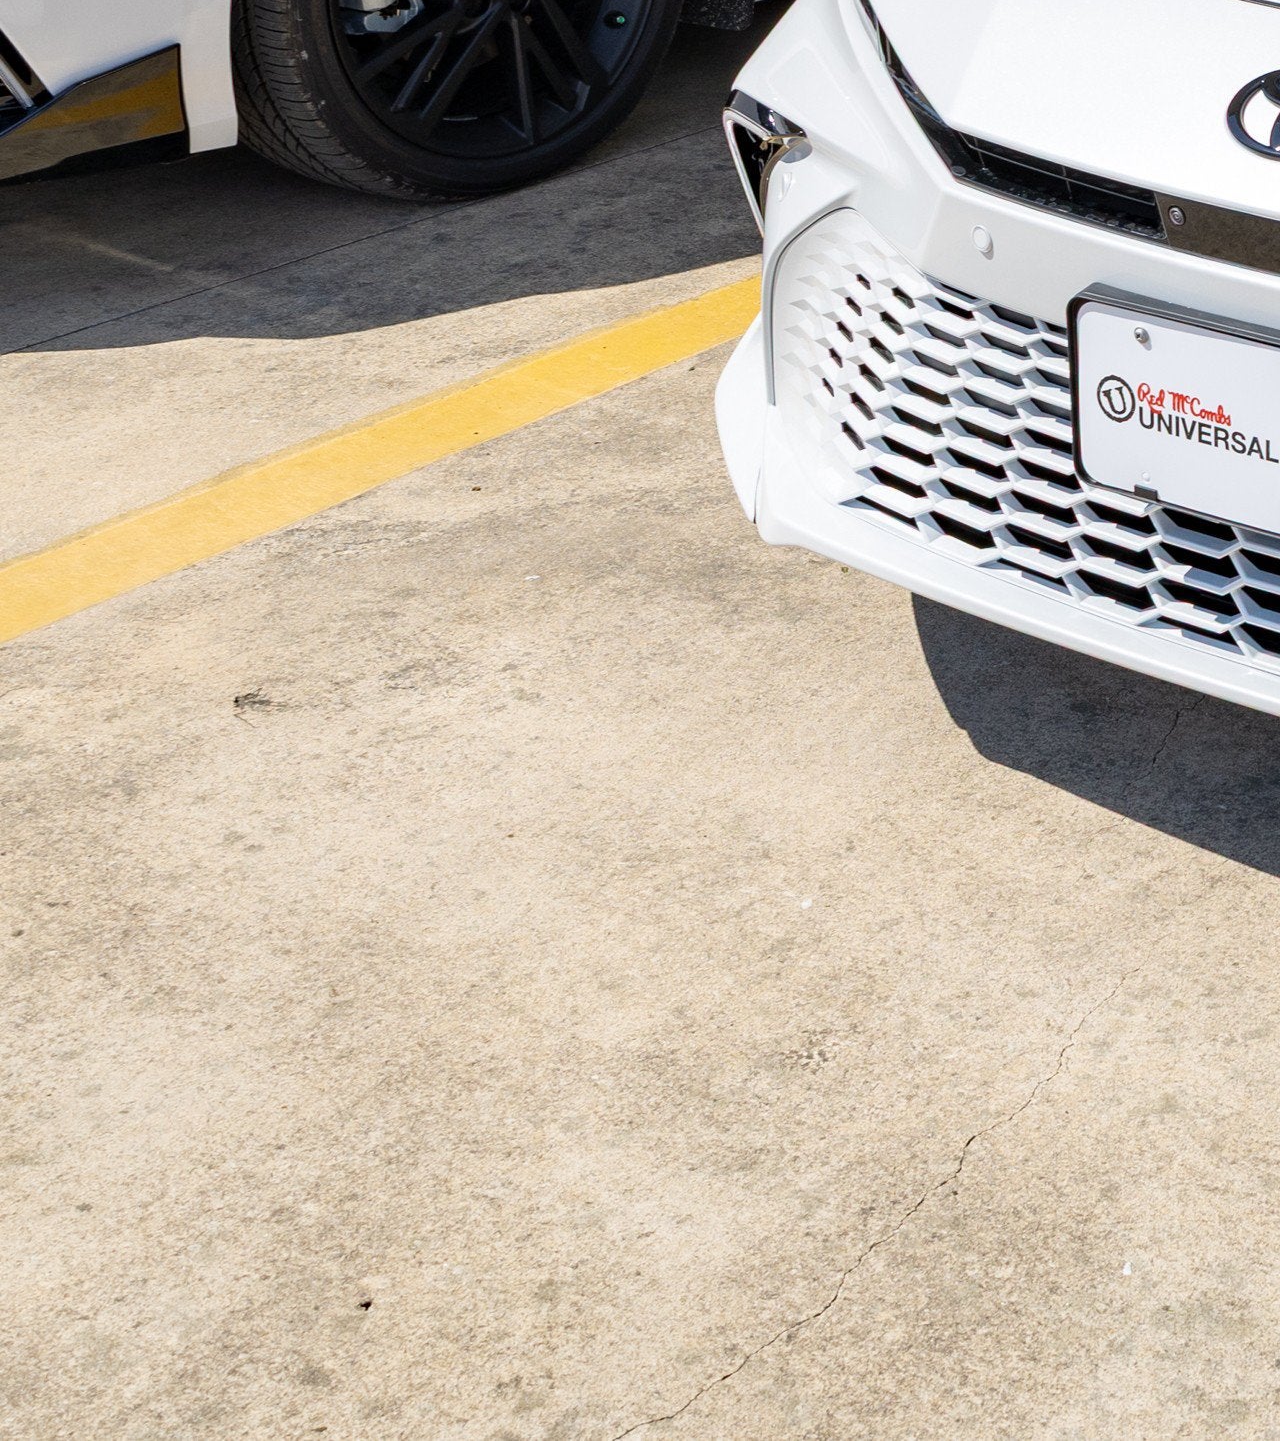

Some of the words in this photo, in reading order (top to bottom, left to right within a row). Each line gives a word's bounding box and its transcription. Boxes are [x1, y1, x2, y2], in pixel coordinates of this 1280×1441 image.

[1137, 382, 1165, 410] Red
[1168, 391, 1232, 427] McCombs
[1138, 406, 1280, 464] UNIVERSAL
